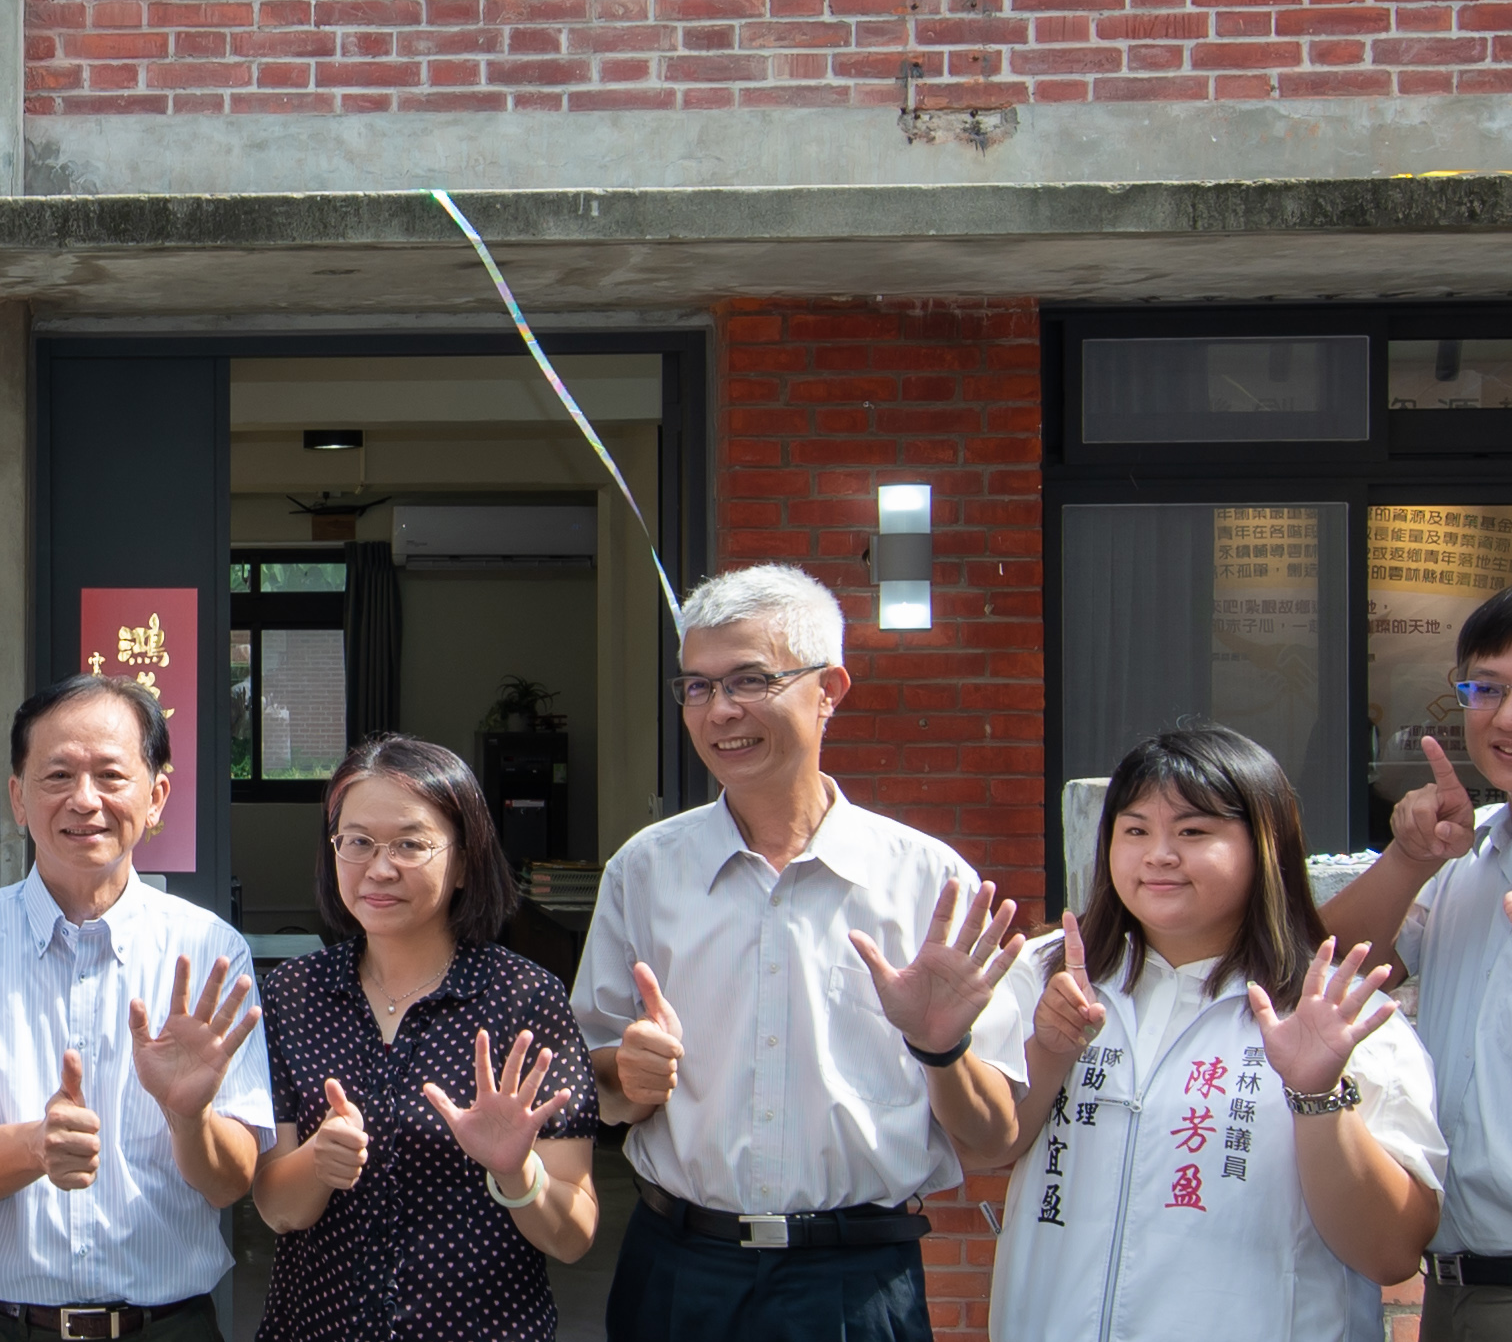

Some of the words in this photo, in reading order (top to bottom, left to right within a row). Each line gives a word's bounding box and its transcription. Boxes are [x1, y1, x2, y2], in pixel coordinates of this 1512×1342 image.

[1214, 562, 1318, 579] 不孤單,創造
[1164, 1056, 1229, 1212] 陳芳盈
[1220, 1045, 1267, 1182] 雲林縣議員
